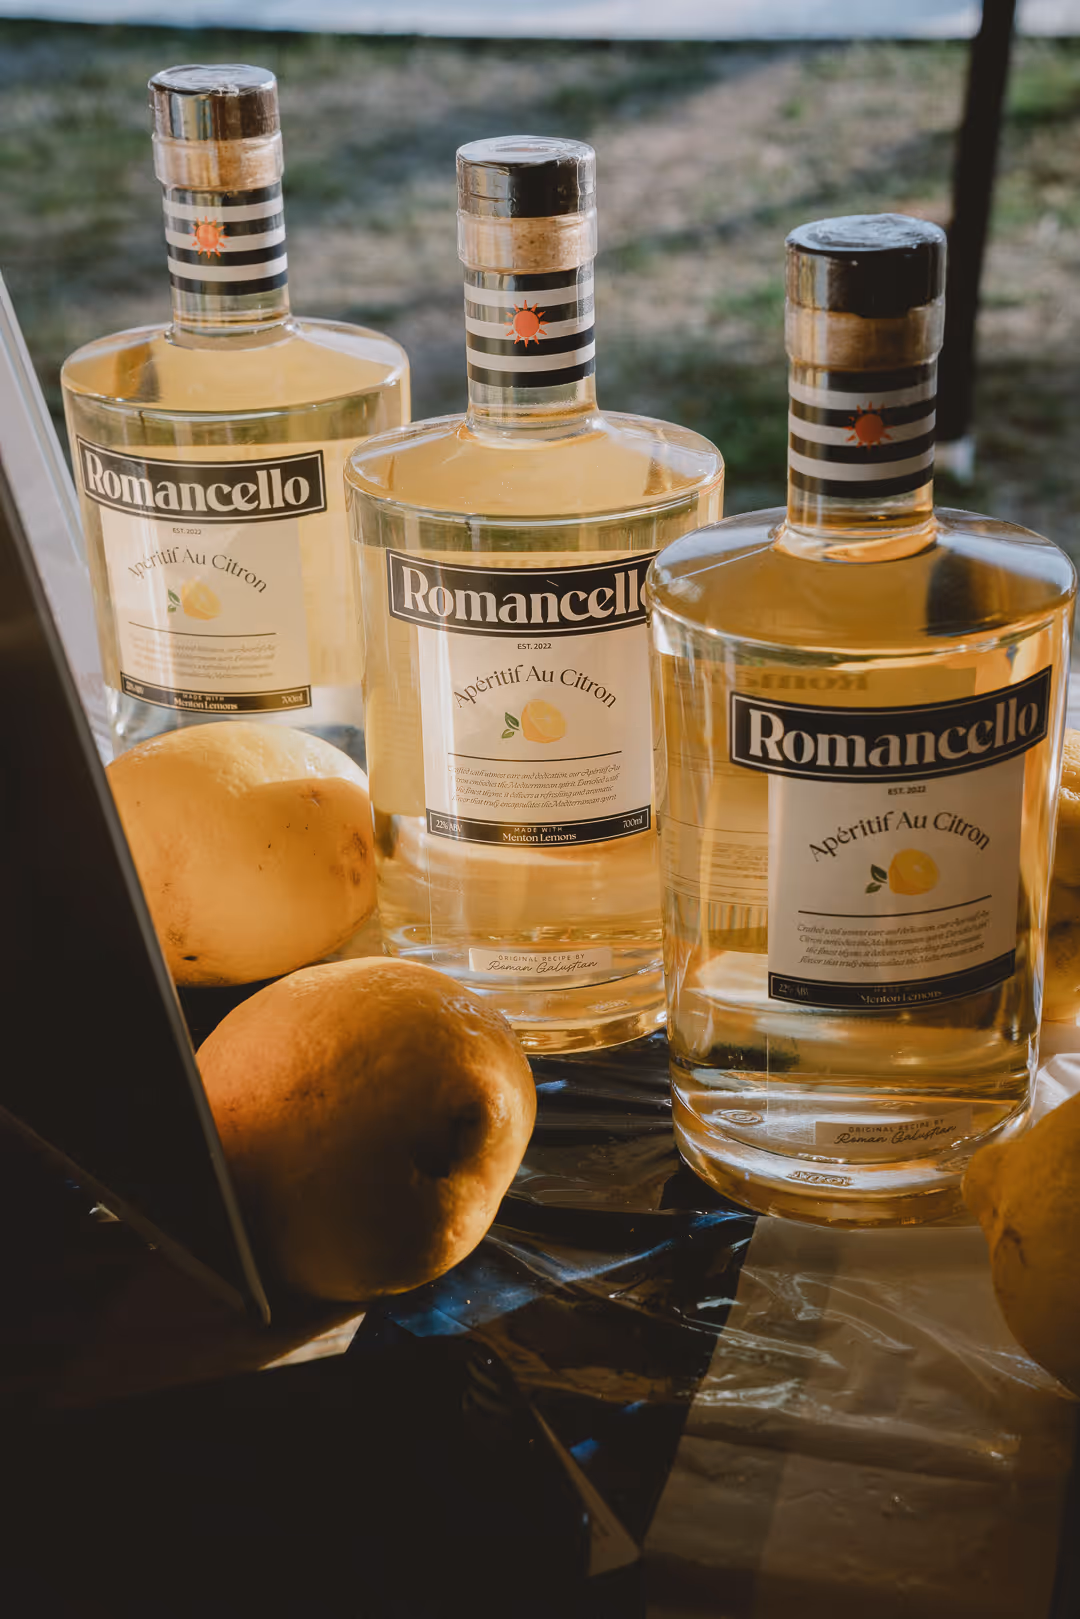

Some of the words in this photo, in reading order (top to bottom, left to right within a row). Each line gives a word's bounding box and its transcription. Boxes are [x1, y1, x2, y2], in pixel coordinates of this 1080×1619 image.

[84, 450, 310, 512] Romancello
[182, 546, 206, 565] Au
[212, 554, 267, 593] Citron
[453, 664, 524, 708] Apéritif
[525, 665, 554, 683] Au
[560, 668, 617, 708] Citron
[204, 699, 238, 710] Lemons
[749, 697, 1039, 768] Romancello
[623, 815, 643, 829] 700ml
[809, 811, 895, 862] Apéritif
[895, 811, 928, 830] Au
[932, 812, 990, 851] Citron
[502, 832, 539, 842] Menton
[540, 832, 577, 842] Lemons
[486, 960, 533, 971] Roman
[498, 954, 538, 962] ORIGINAL
[542, 954, 571, 962] RECIPE
